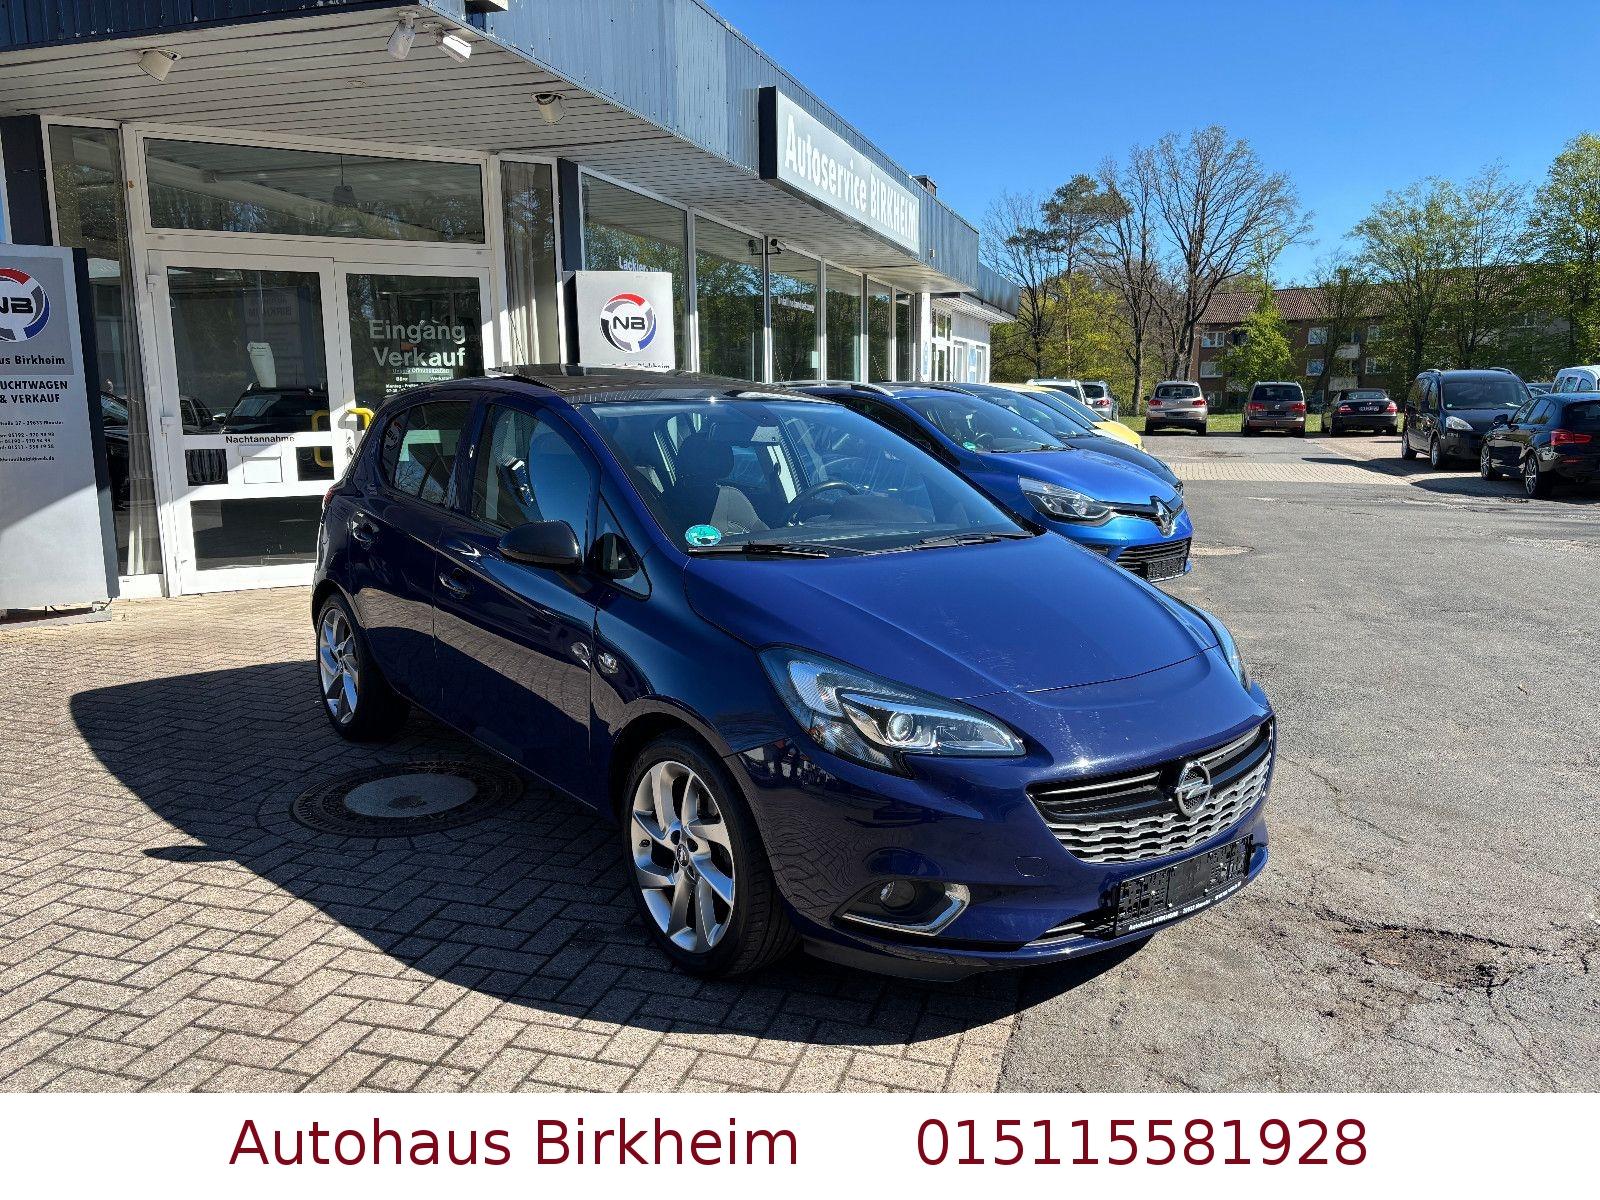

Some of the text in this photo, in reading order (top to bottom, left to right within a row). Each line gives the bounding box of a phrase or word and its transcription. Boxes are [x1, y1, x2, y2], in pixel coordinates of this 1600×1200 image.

[784, 112, 917, 243] Autoservice BIRKHEIM
[369, 319, 466, 344] Eingang
[612, 315, 646, 331] NB
[14, 354, 66, 365] Birkheim
[372, 346, 466, 367] Verkauf
[10, 393, 60, 404] VERKAUF
